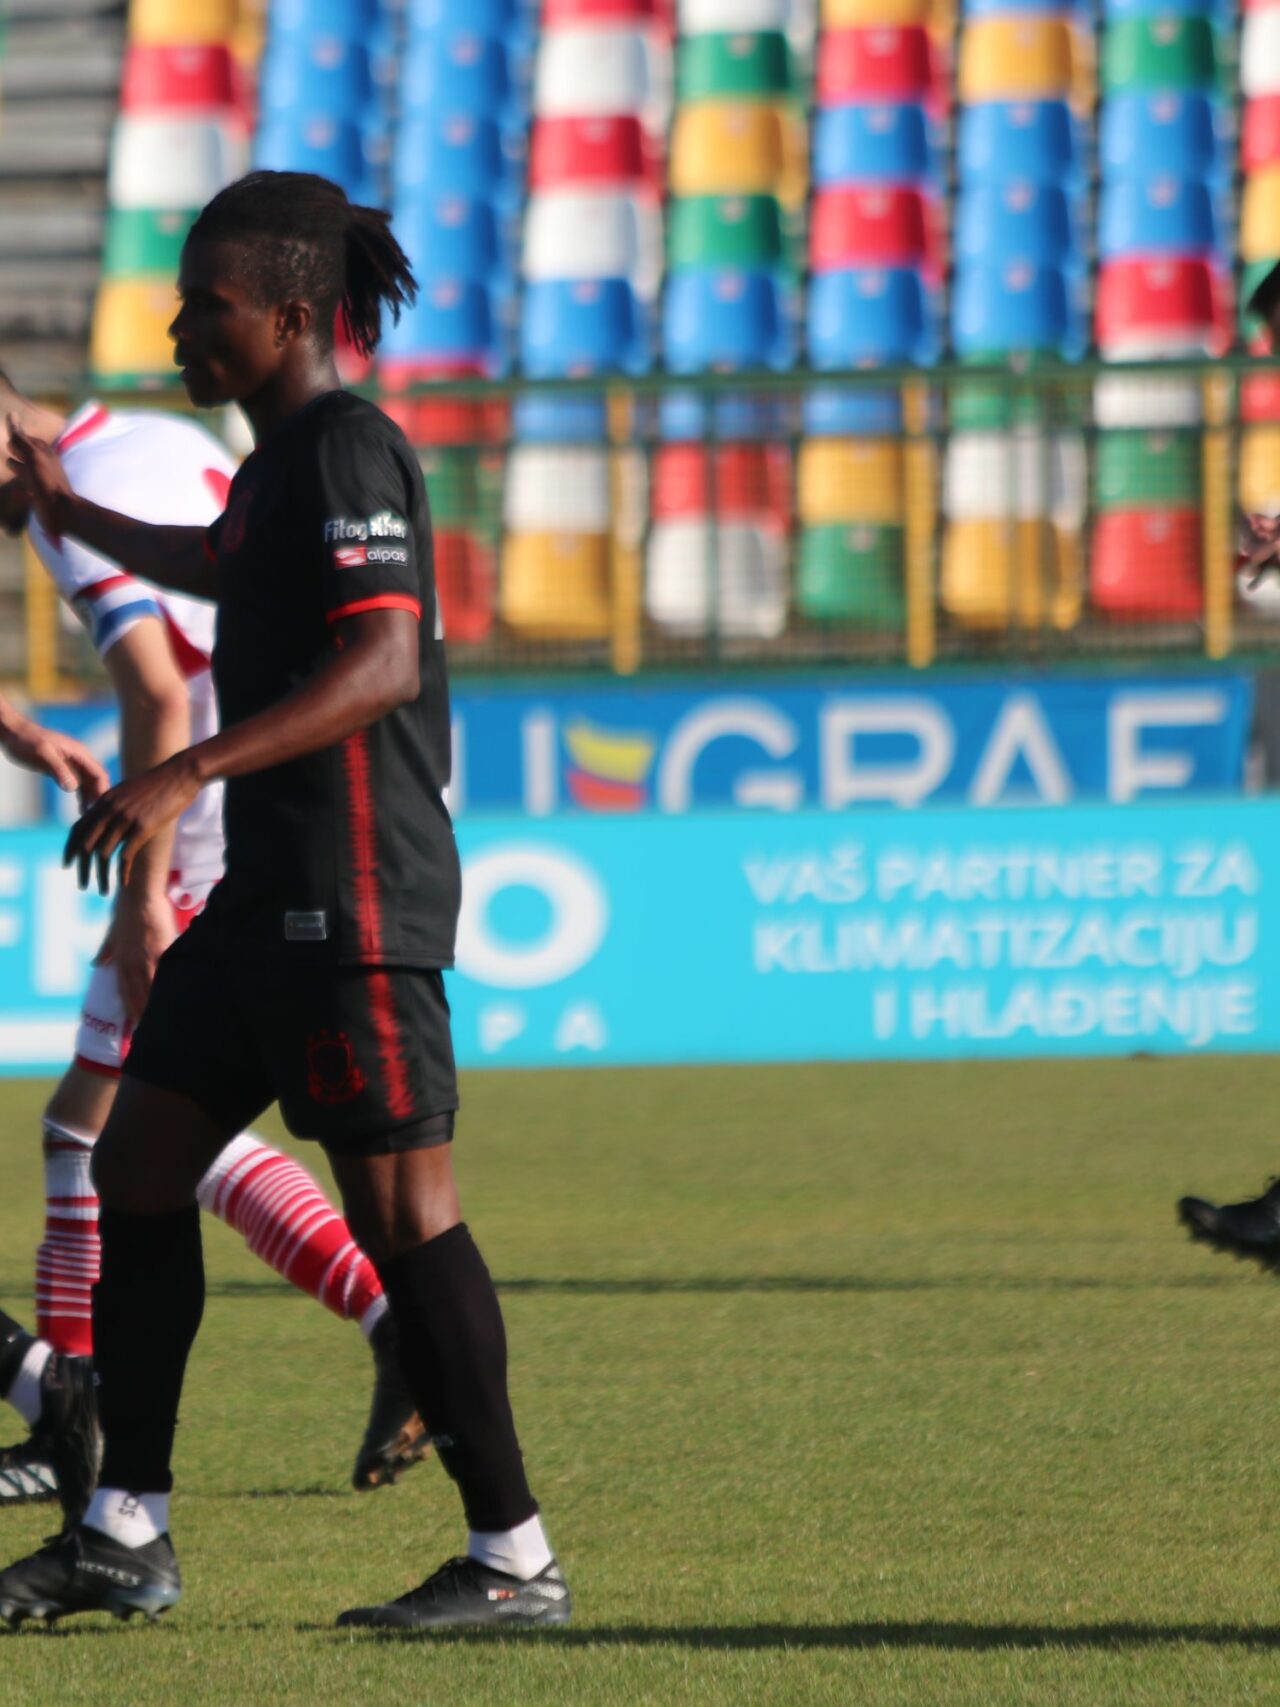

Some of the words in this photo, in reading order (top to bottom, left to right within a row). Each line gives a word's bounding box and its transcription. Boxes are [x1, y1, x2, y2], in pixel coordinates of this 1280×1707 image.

[366, 549, 407, 564] alpas
[746, 840, 864, 902] VAŠ
[877, 851, 1161, 900] PARTNER
[1174, 848, 1258, 897] ZA
[754, 912, 1257, 977] KLIMATIZACIJU
[874, 984, 897, 1038] I
[910, 981, 1256, 1047] HLAĐENJE
